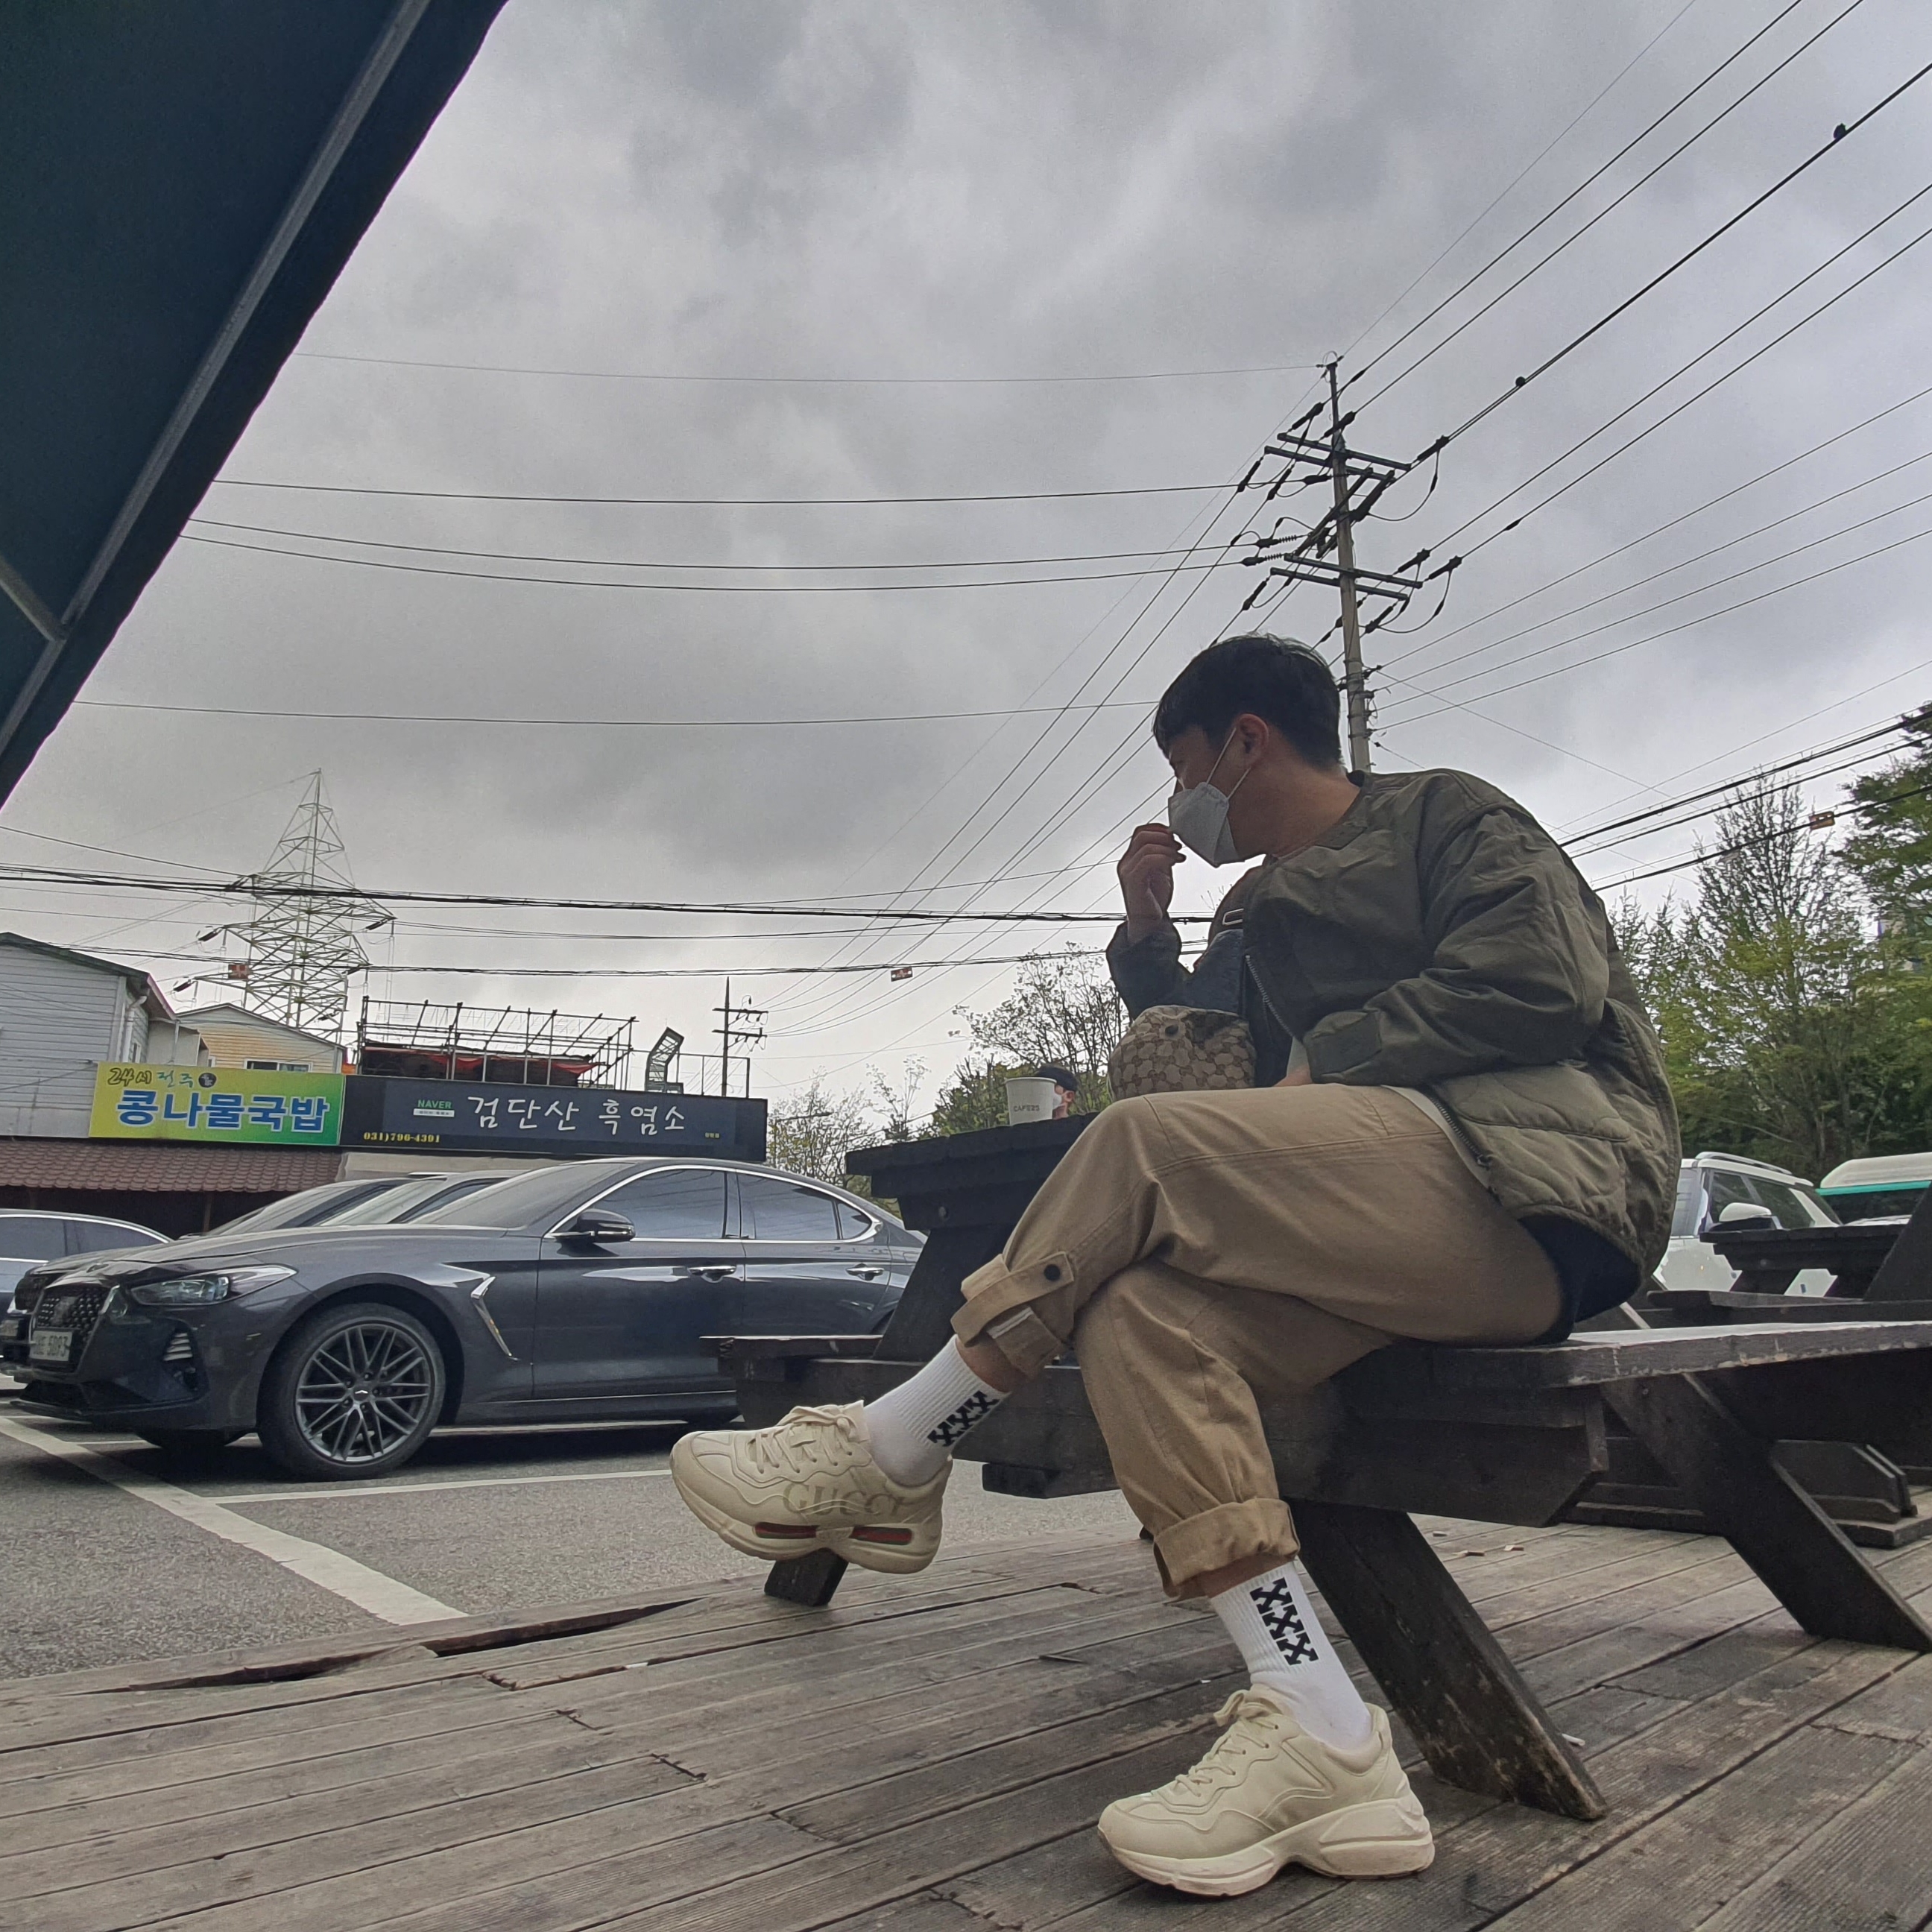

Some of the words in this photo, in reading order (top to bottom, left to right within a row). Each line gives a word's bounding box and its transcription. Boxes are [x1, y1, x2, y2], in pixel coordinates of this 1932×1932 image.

[107, 1067, 152, 1087] 24시
[157, 1070, 194, 1088] 전주
[116, 1089, 331, 1133] 콩나물국밥
[417, 1099, 452, 1109] NAVER
[467, 1096, 580, 1131] 검단산
[599, 1099, 686, 1136] 흑염소
[782, 1482, 905, 1518] GUCCI
